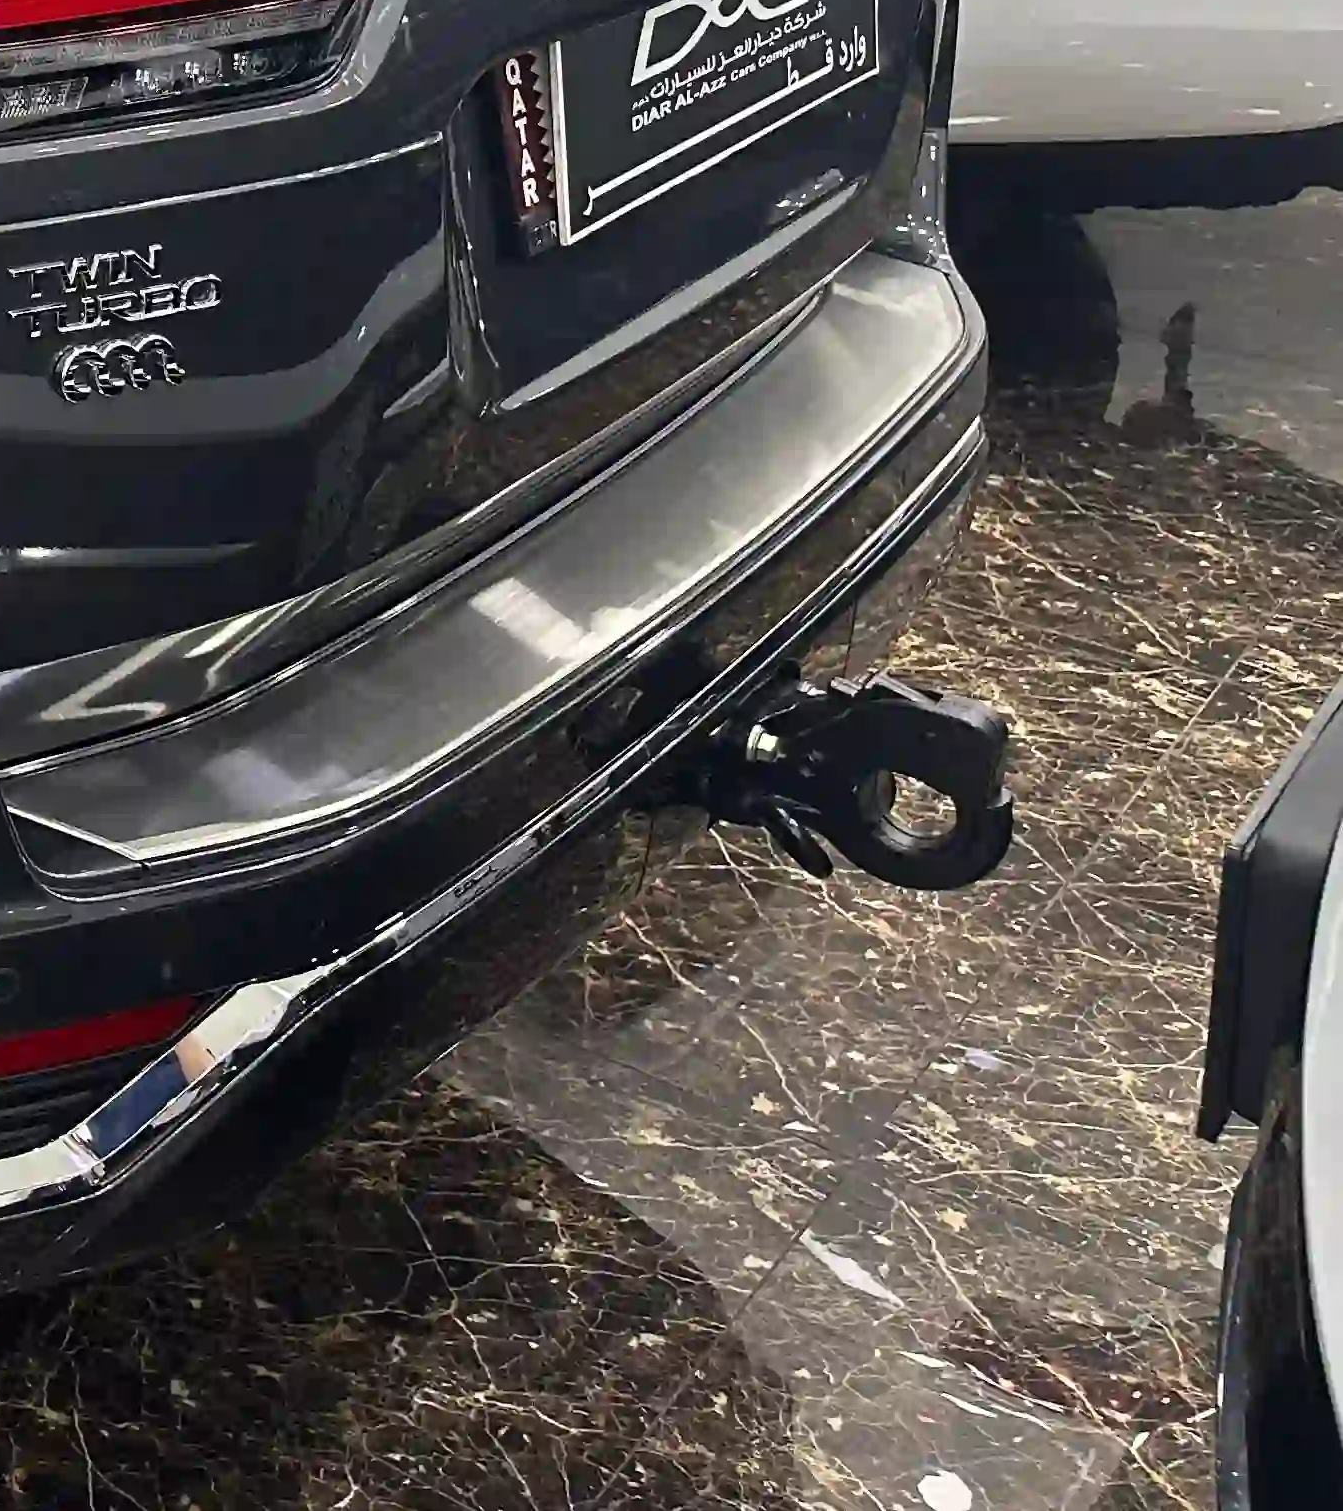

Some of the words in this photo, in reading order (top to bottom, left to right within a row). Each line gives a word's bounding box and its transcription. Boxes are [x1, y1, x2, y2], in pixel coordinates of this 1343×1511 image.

[750, 26, 783, 56] ديار
[782, 0, 827, 36] شركة
[717, 36, 752, 72] العز
[836, 25, 867, 73] وارد
[631, 99, 673, 132] DIAR
[730, 62, 757, 82] Cars
[758, 35, 808, 68] Company
[649, 54, 717, 98] للسيارات
[505, 57, 540, 208] QATAR
[6, 243, 164, 300] TWIN
[5, 273, 223, 339] TURBO
